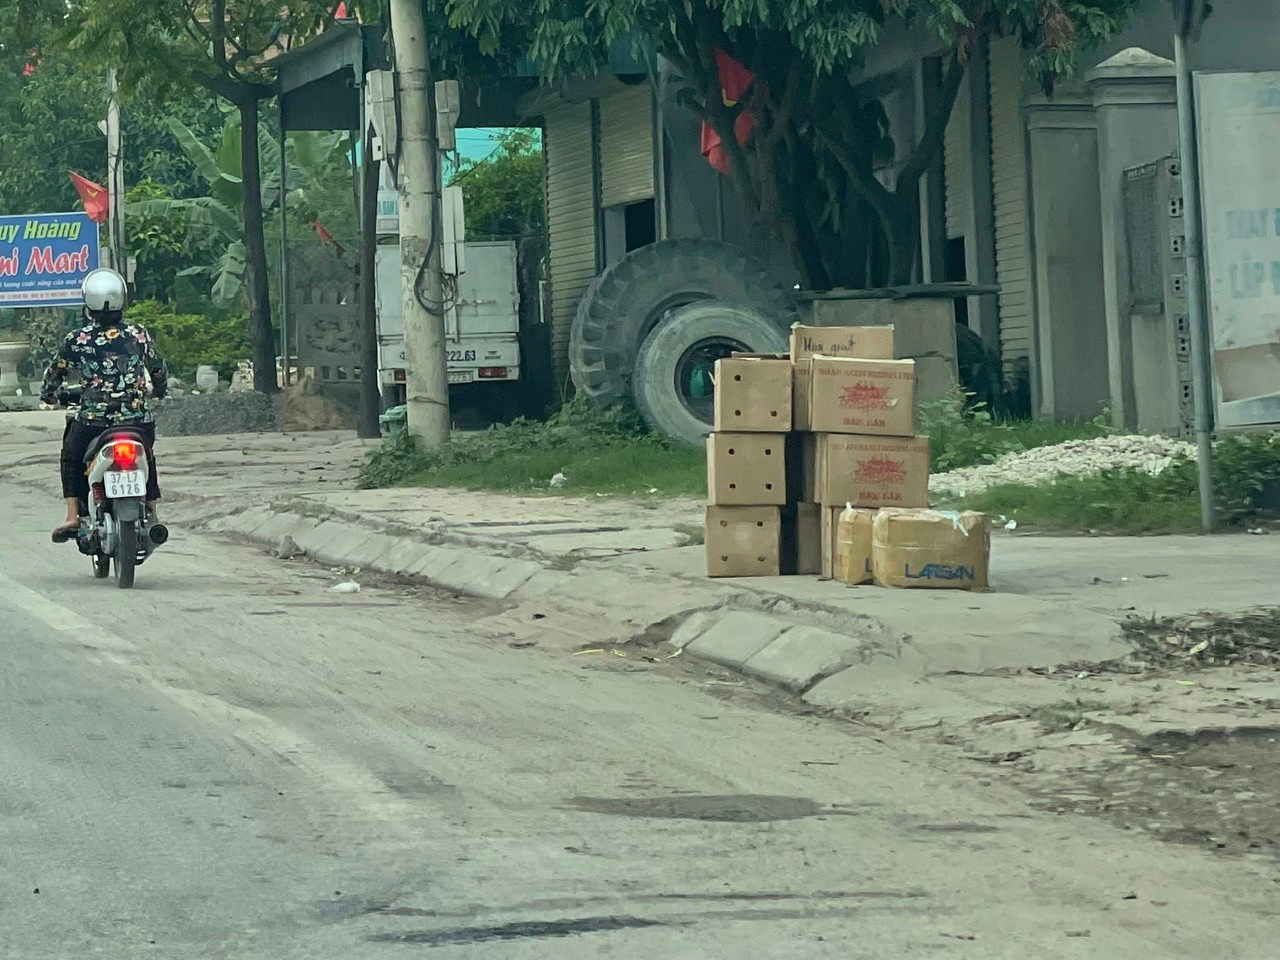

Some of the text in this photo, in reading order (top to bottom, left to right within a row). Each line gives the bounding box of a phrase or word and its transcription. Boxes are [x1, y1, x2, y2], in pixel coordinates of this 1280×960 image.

[23, 219, 82, 240] Hoàng
[24, 244, 89, 275] Mart
[111, 483, 141, 496] 6126
